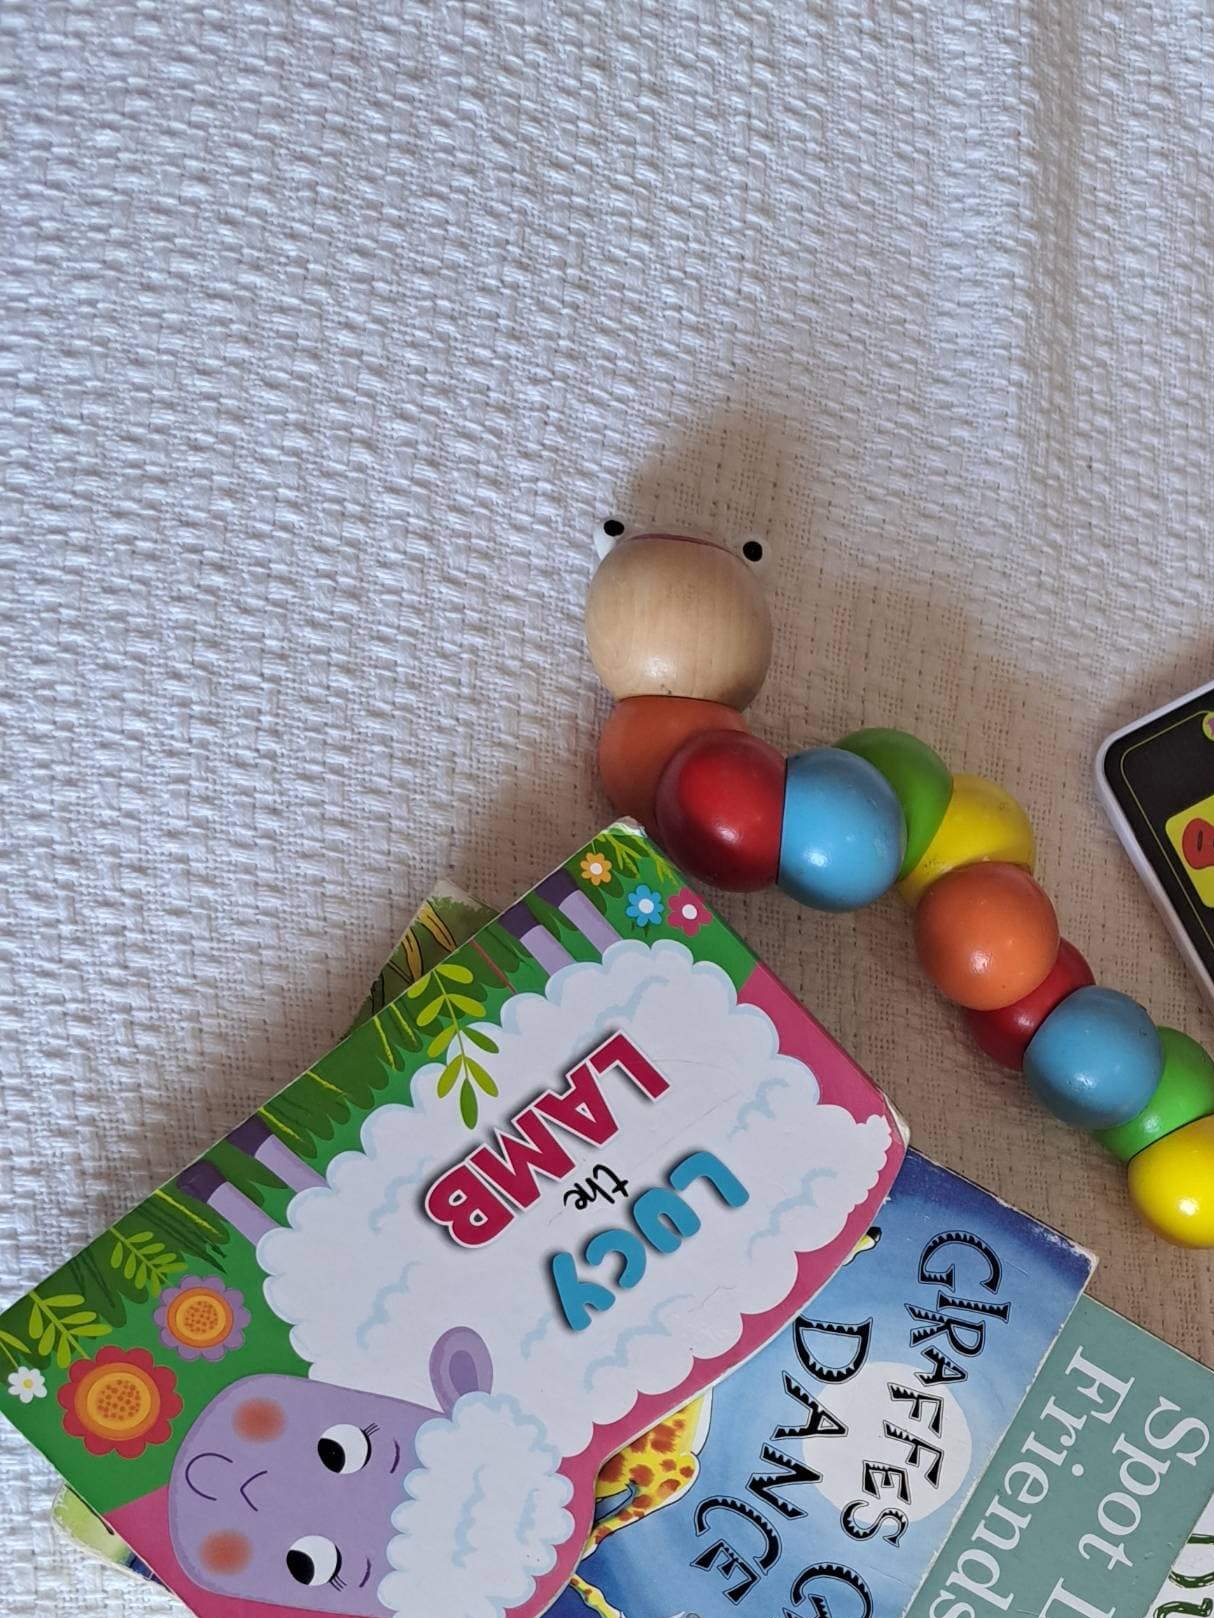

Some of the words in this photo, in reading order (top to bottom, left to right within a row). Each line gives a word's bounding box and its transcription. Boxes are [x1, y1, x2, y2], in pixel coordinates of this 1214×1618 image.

[425, 1029, 671, 1248] LAMB
[563, 1164, 629, 1210] the
[552, 1150, 750, 1332] LUCY
[691, 1315, 874, 1605] DANCE
[840, 1230, 1012, 1548] GIRAFFES
[1077, 1396, 1211, 1571] Spot
